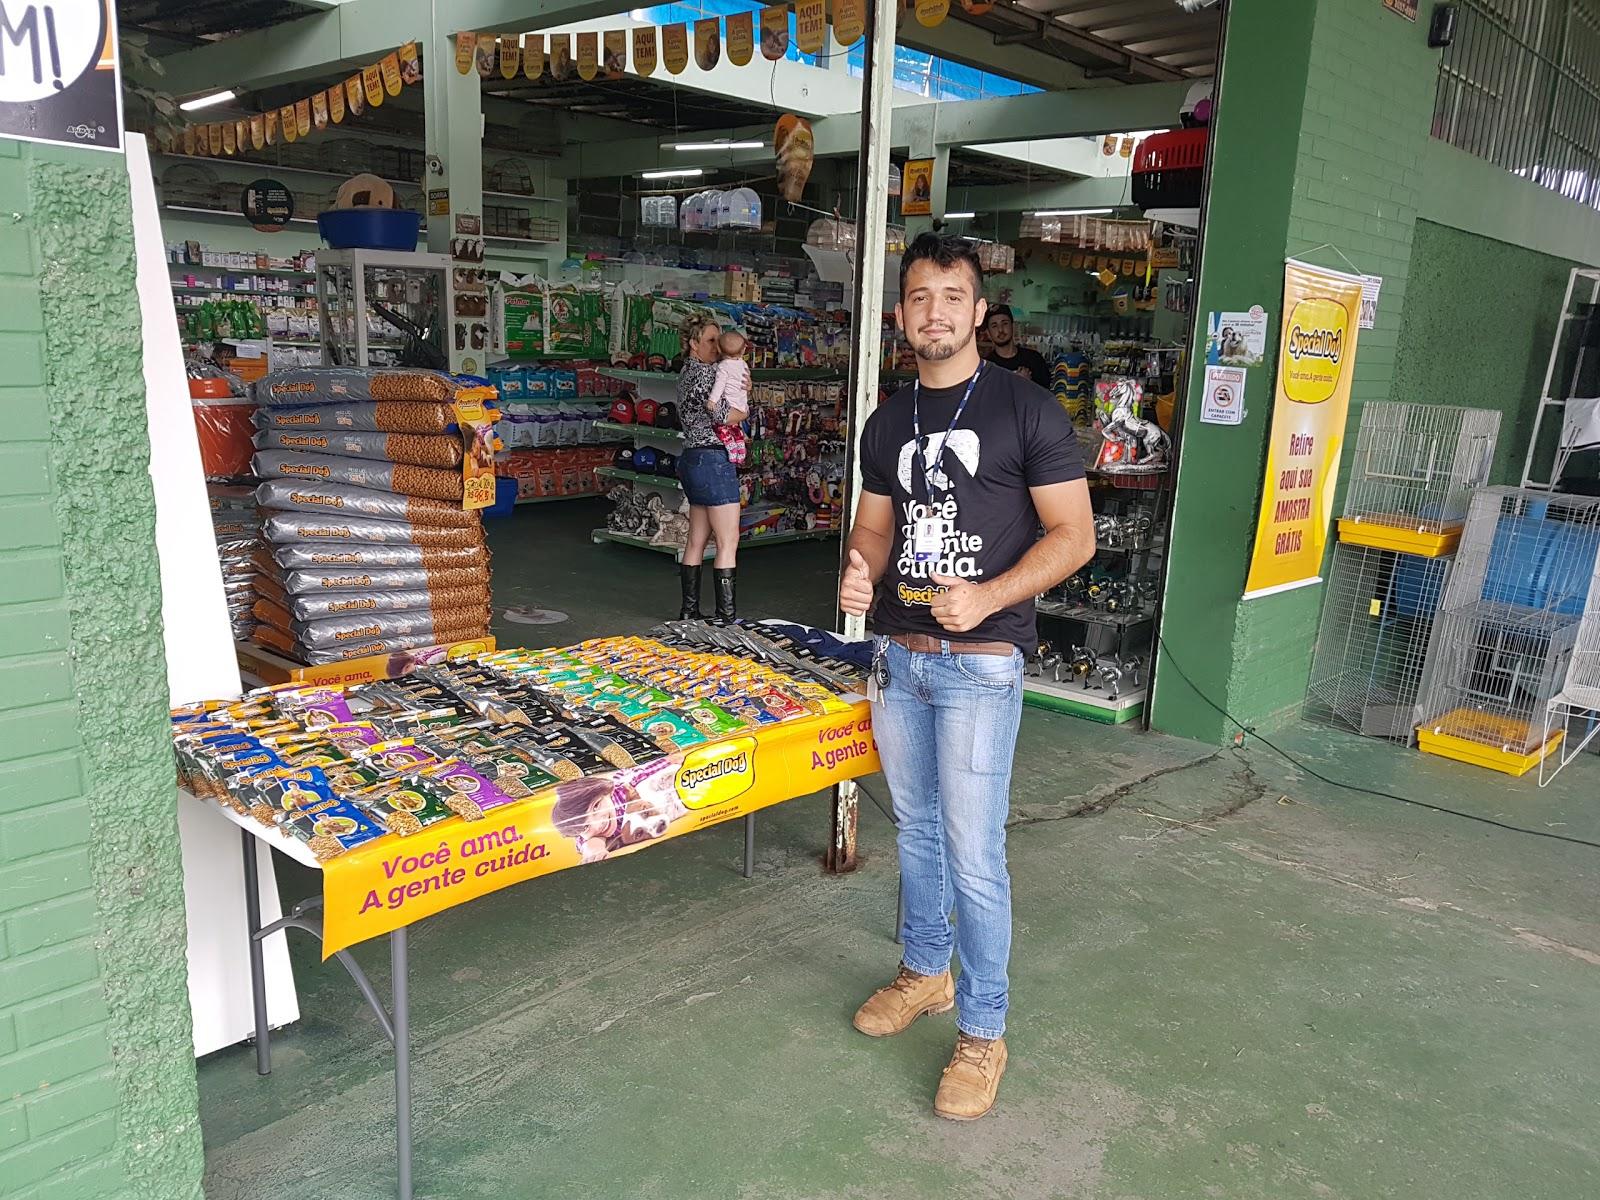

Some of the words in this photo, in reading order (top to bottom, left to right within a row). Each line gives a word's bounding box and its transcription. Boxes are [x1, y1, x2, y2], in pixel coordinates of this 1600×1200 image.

[799, 3, 822, 20] AQUI
[800, 18, 822, 34] TEM!
[502, 39, 518, 49] AQUI
[636, 32, 654, 45] AQUI
[502, 51, 517, 61] TEM!
[636, 46, 655, 58] TEM!
[1289, 325, 1325, 360] Special
[1324, 328, 1342, 364] Dog
[272, 383, 299, 394] Special
[300, 382, 316, 392] Dog
[275, 413, 303, 425] Special
[304, 412, 320, 425] Dog
[279, 434, 309, 446] Special
[310, 437, 328, 449] Dog
[1289, 433, 1314, 456] Retire
[279, 463, 311, 475] Special
[312, 465, 330, 477] Dog
[1280, 467, 1298, 492] aqui
[1299, 470, 1313, 488] sua
[290, 493, 324, 505] Special
[324, 495, 344, 508] Dog
[902, 494, 958, 524] Você
[1274, 498, 1310, 523] AMOSTRA
[298, 526, 330, 537] Special
[330, 526, 351, 538] Dog
[1275, 528, 1303, 556] GRÁTIS
[312, 553, 344, 564] Special
[344, 552, 363, 563] Dog
[321, 576, 352, 588] Special
[353, 575, 371, 586] Dog
[328, 600, 358, 613] Special
[358, 599, 377, 609] Dog
[335, 627, 365, 641] Special
[365, 624, 382, 636] Dog
[342, 645, 370, 659] Special
[370, 640, 387, 652] Dog
[312, 674, 341, 687] Você
[344, 671, 373, 682] ama.
[811, 751, 825, 770] A
[825, 739, 868, 770] gente
[681, 759, 723, 789] Special
[723, 751, 747, 775] Dog
[381, 841, 451, 880] Você
[460, 824, 524, 858] ama.
[358, 889, 383, 915] A
[387, 867, 466, 910] gente
[475, 843, 551, 878] cuida.
